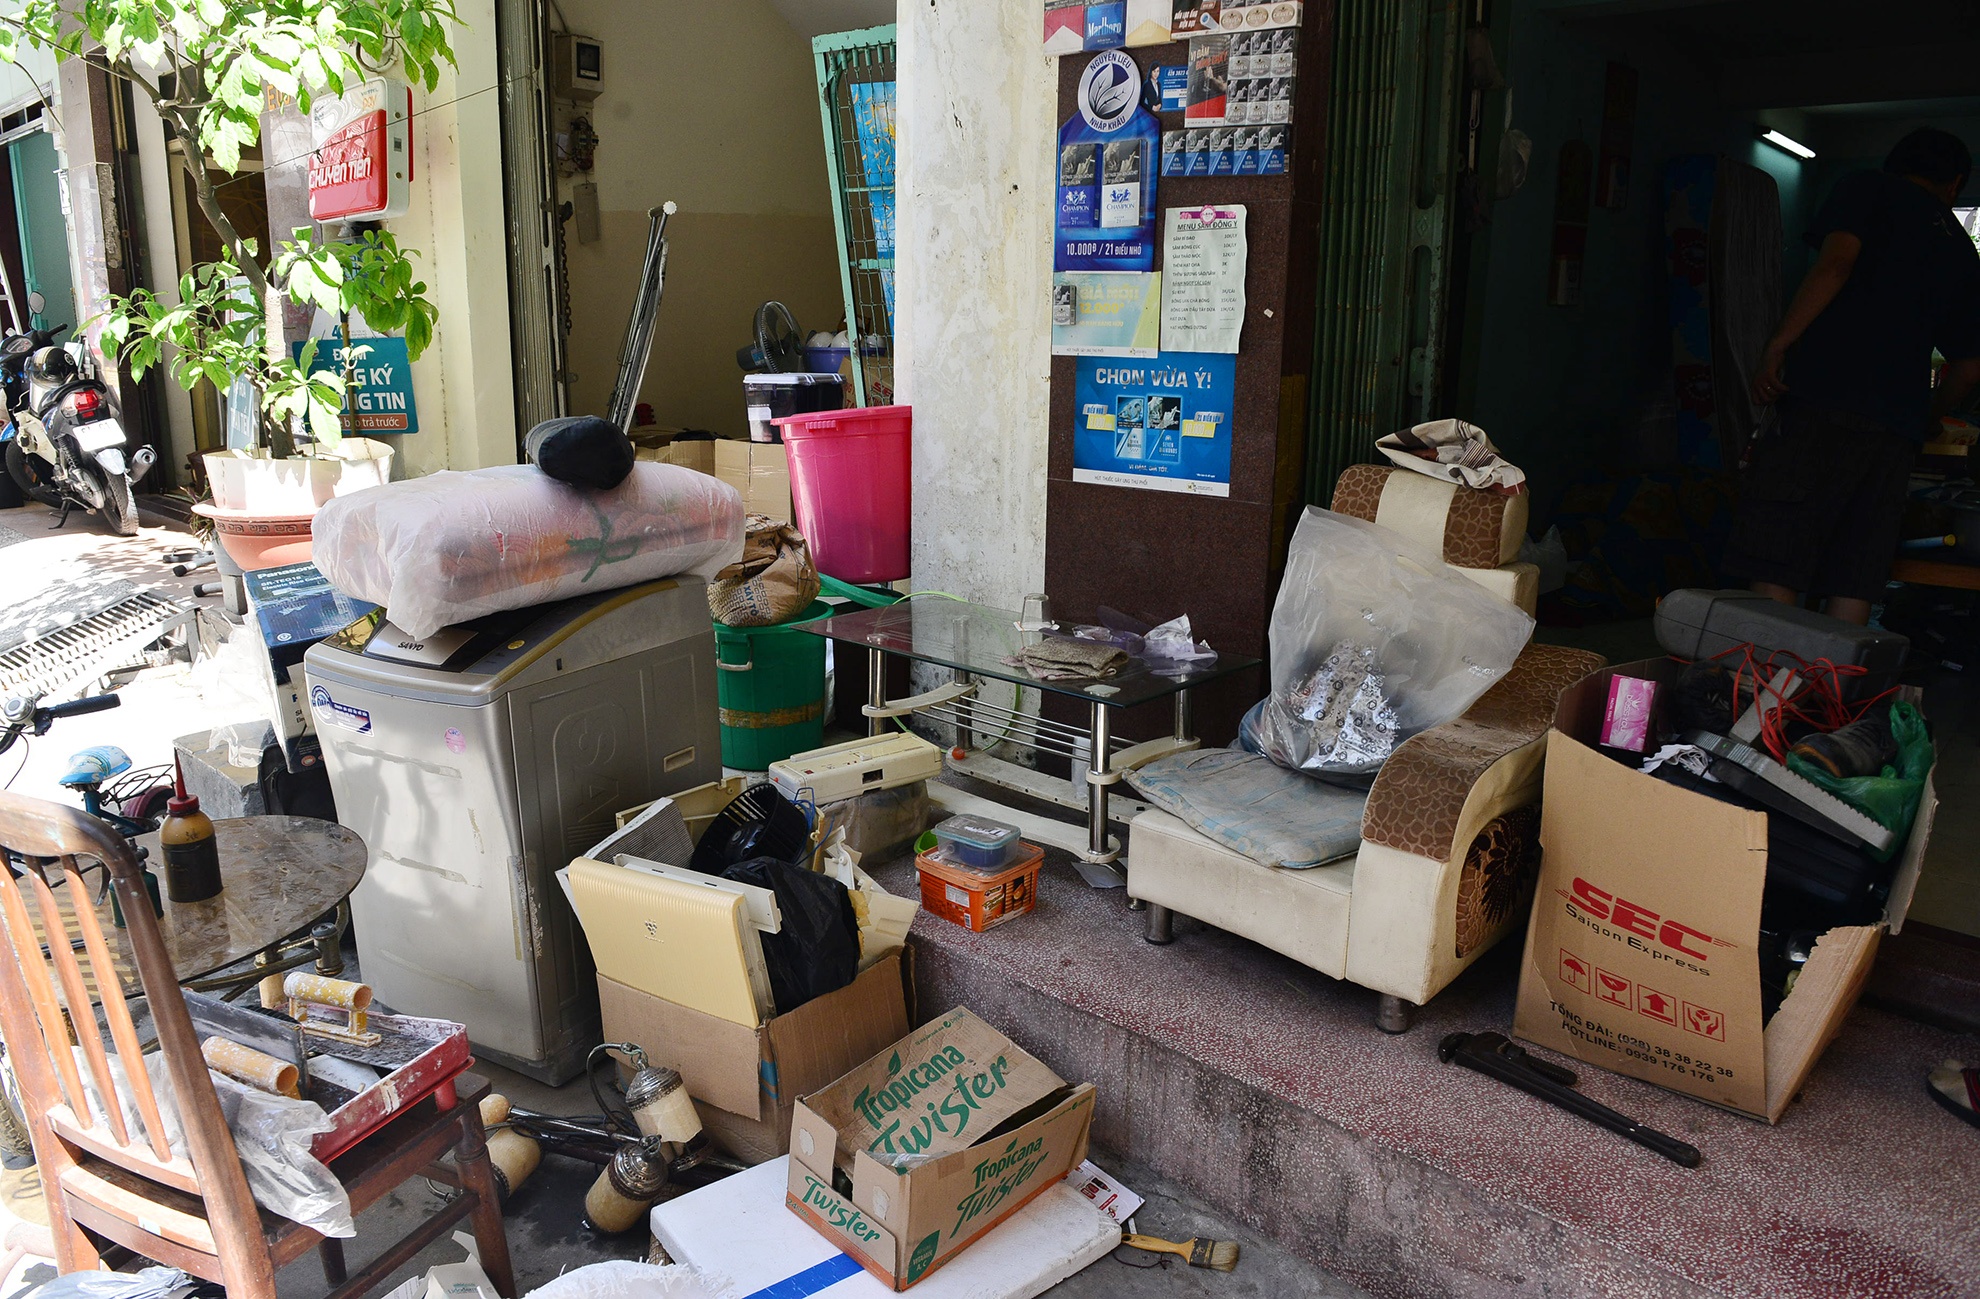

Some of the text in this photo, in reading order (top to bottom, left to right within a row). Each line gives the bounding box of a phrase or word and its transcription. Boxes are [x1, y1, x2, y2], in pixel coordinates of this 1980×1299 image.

[1088, 17, 1121, 38] Marlboro
[1105, 243, 1114, 255] 21
[370, 363, 393, 385] KÝ
[873, 382, 892, 396] SE
[1096, 365, 1212, 389] CHỌN VỪA Ý!
[345, 416, 400, 427] bo trả trước
[374, 392, 406, 410] TIN
[398, 641, 424, 651] SANYO
[1565, 903, 1710, 977] Saigon Express
[1569, 877, 1713, 962] SEC
[1550, 1000, 1734, 1078] TỔNG ĐÀI: (028) 38 38 22 38
[1562, 1020, 1715, 1083] HOTLINE: 0939 176 176
[853, 1045, 966, 1130] Tropicana
[868, 1055, 1008, 1170] Twister
[972, 1137, 1043, 1189] Tropicana
[804, 1175, 880, 1242] Twister
[949, 1151, 1049, 1239] Twister
